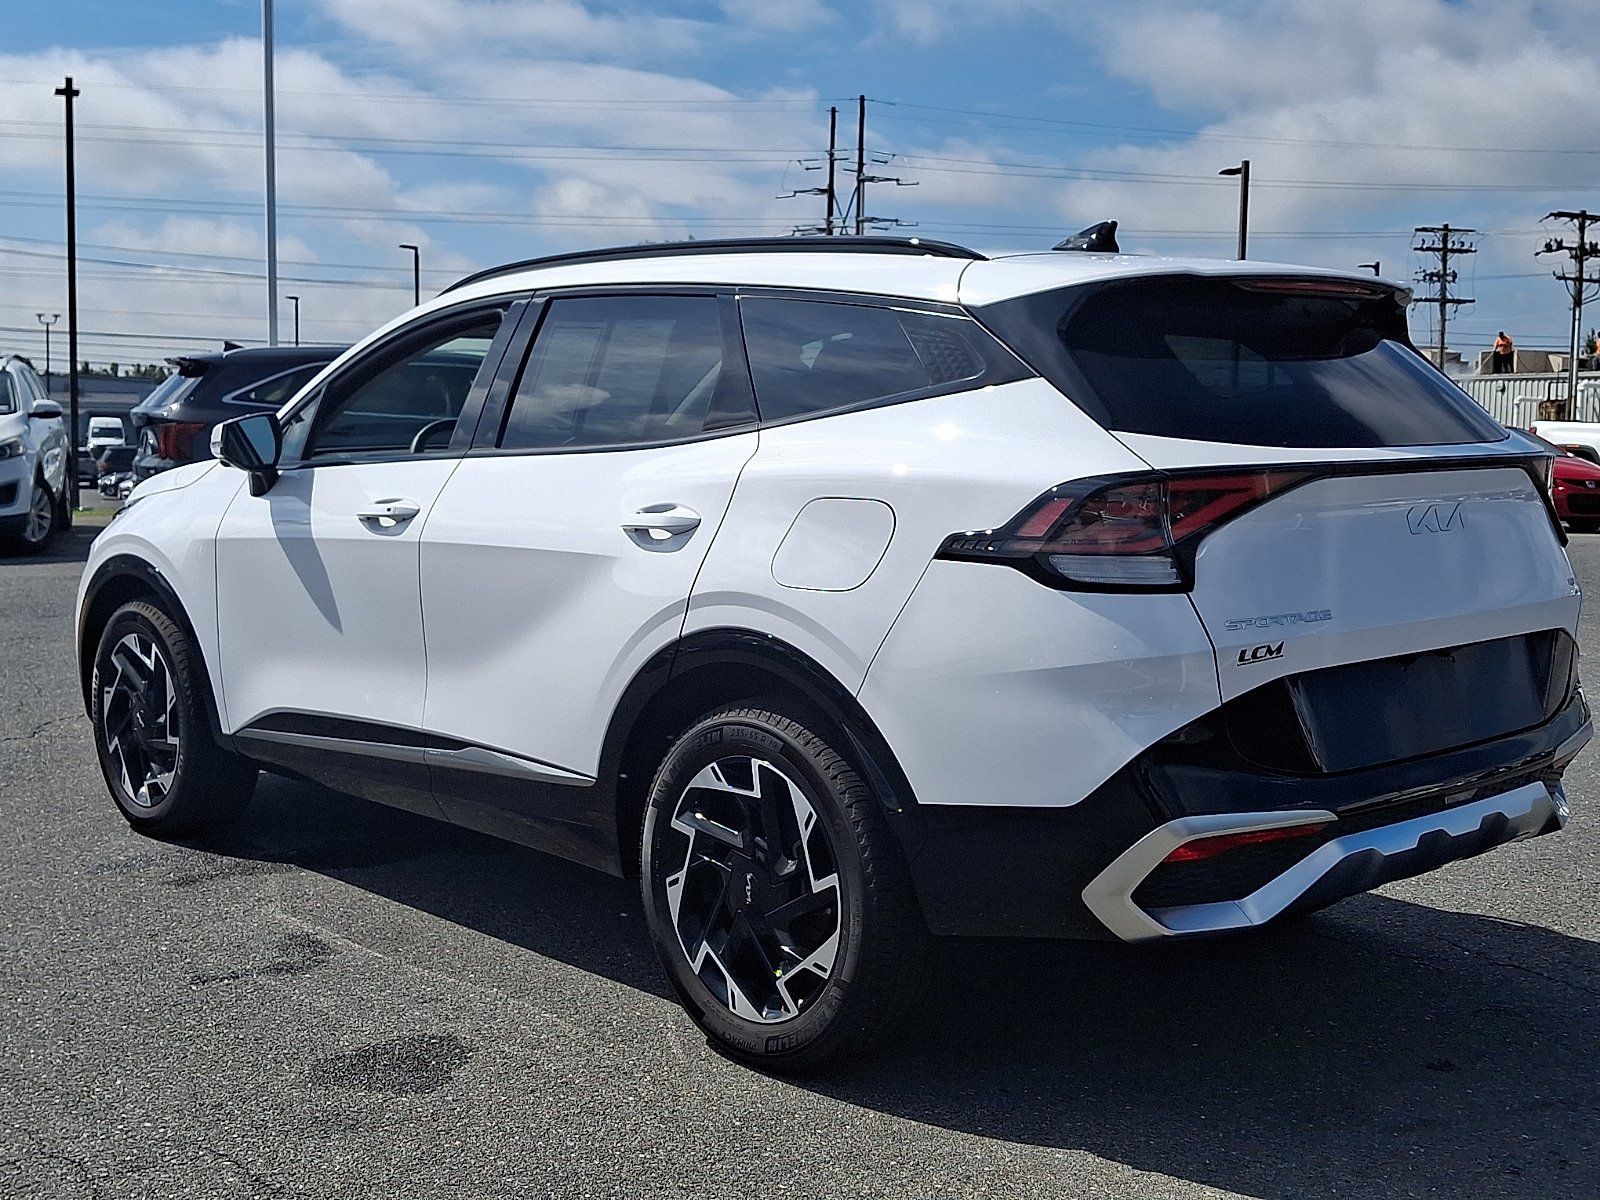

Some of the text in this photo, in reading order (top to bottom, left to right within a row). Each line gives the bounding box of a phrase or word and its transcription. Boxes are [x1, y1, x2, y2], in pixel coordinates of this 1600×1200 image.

[1406, 502, 1465, 535] KIA
[1224, 609, 1333, 632] SPORTAGE
[1237, 641, 1285, 663] LCM
[720, 1031, 758, 1051] PRIMACY
